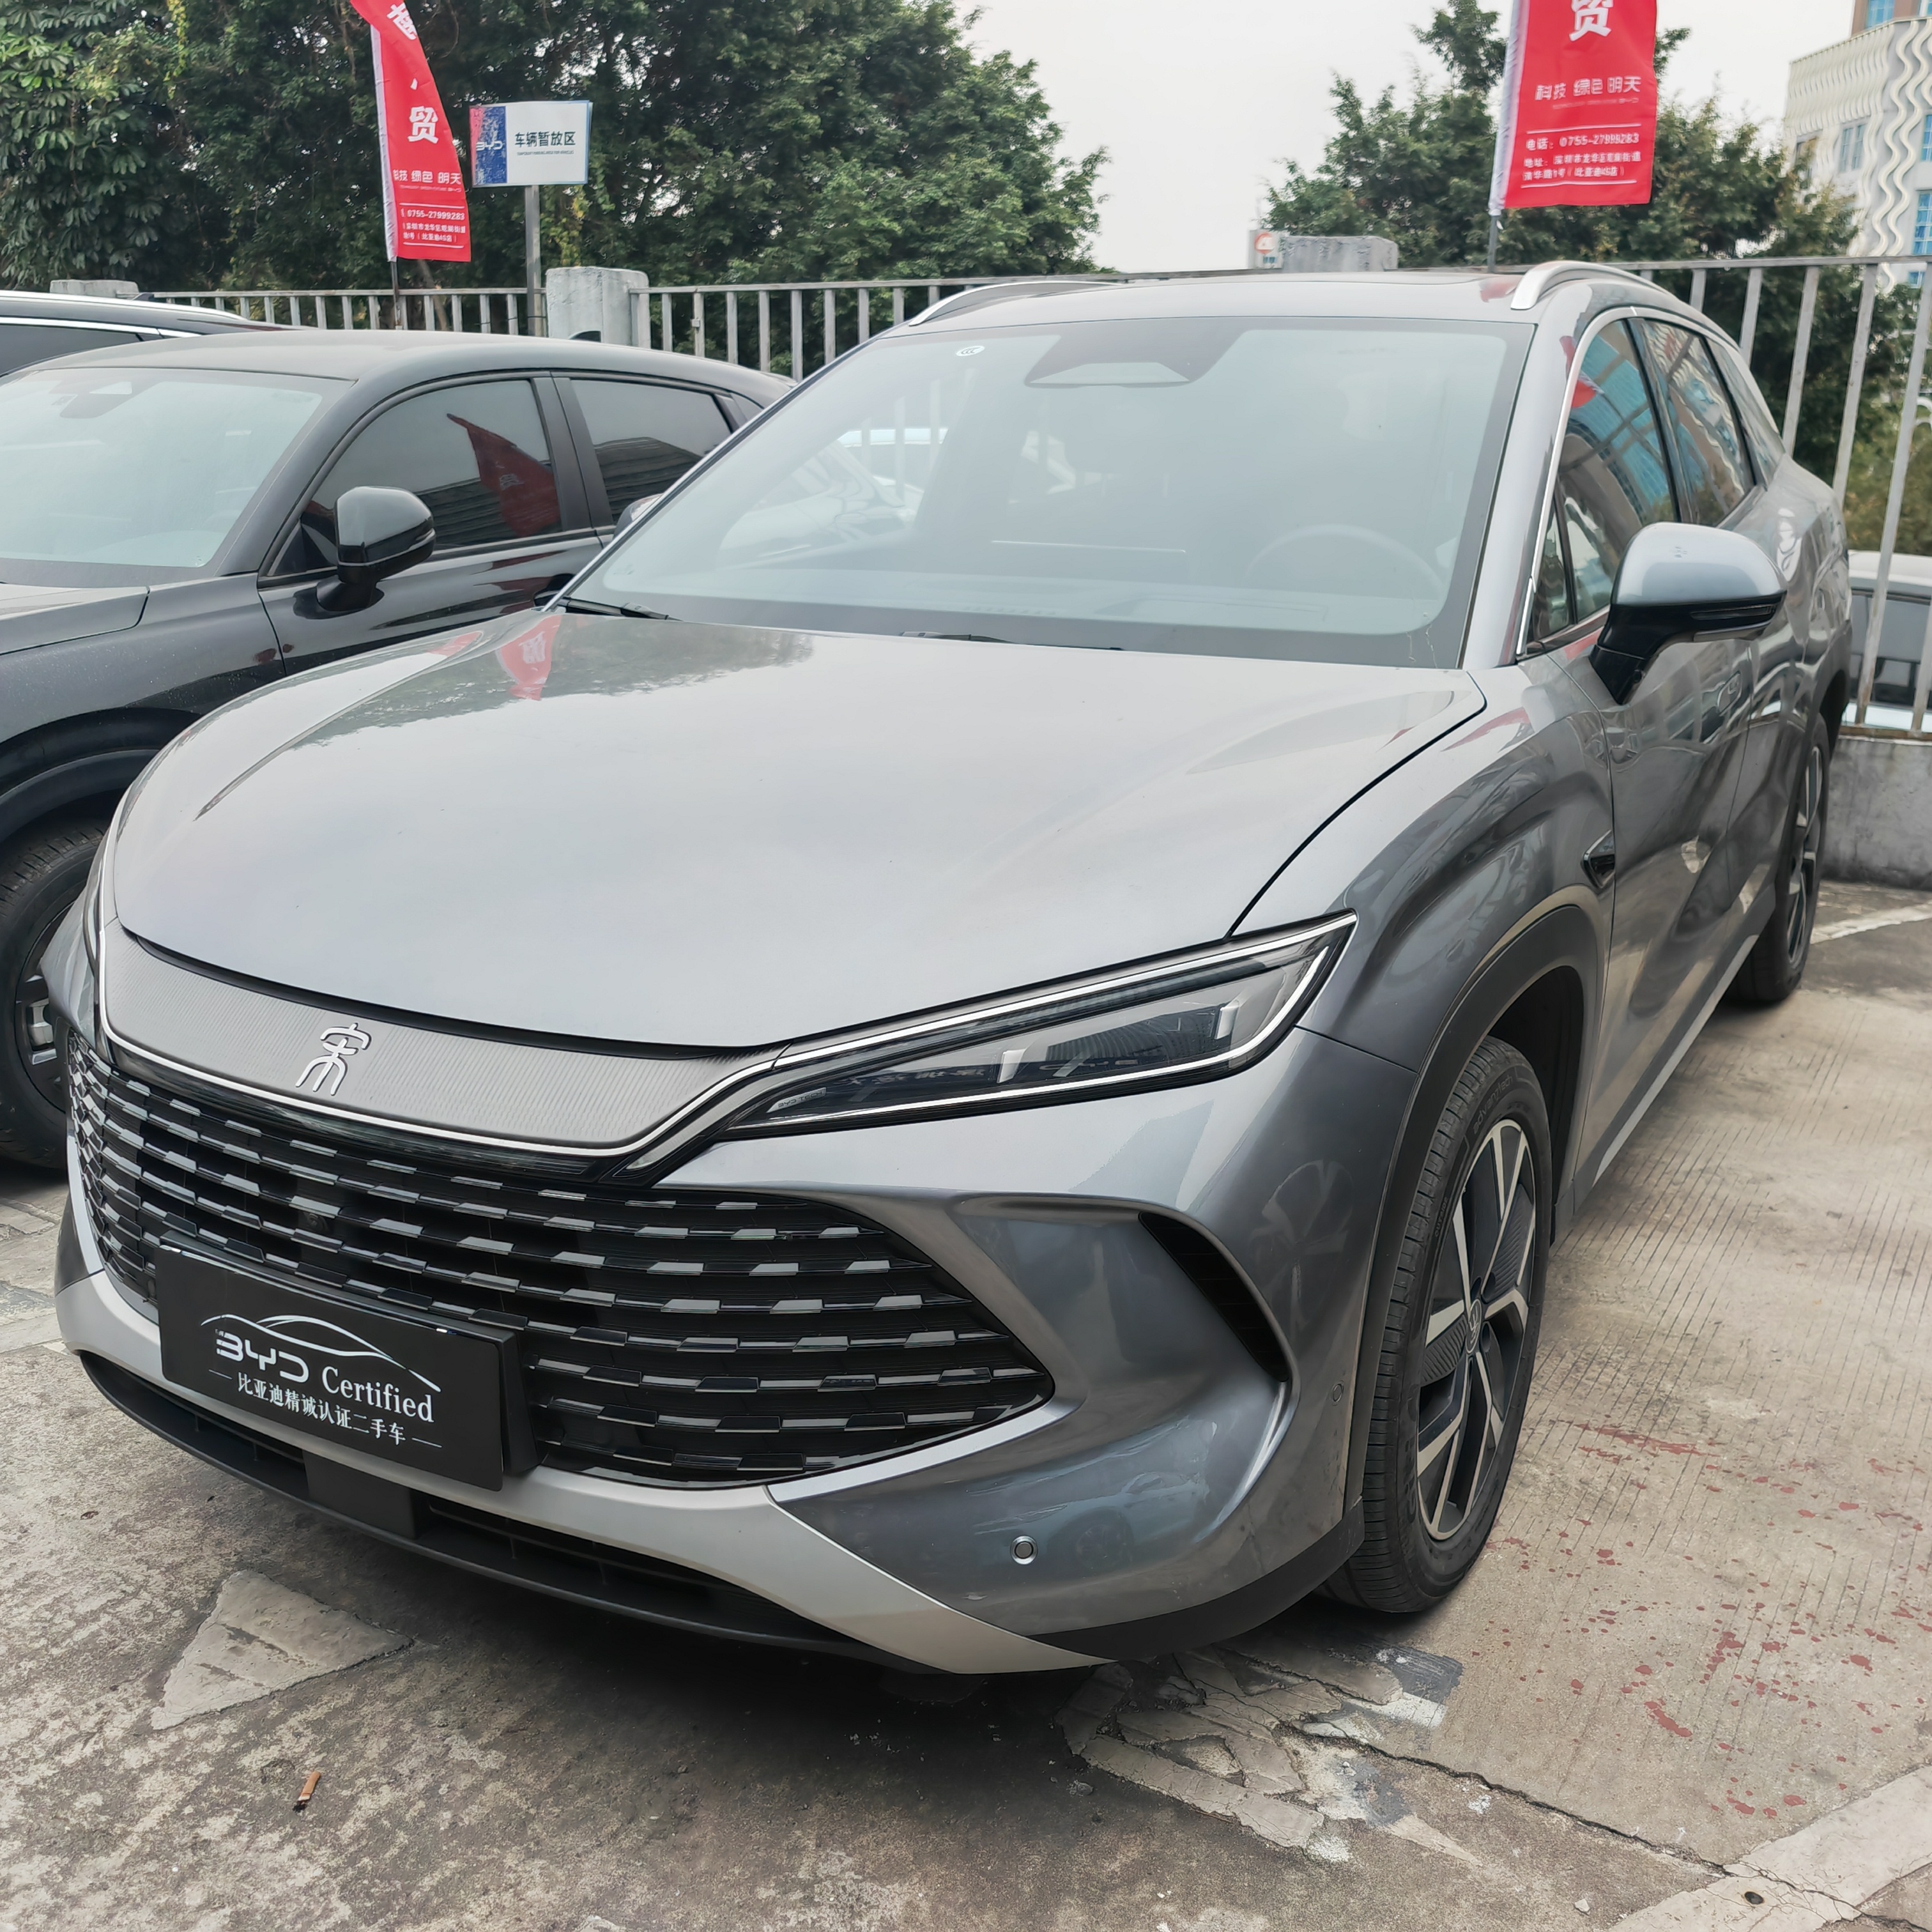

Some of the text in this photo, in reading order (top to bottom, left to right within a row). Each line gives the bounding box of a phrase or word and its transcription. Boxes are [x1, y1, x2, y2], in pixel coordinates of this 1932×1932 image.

[1535, 75, 1641, 100] 科技 绿色 明天
[408, 105, 438, 144] 贸
[475, 140, 503, 151] BYD
[514, 131, 576, 148] 车辆暂放区
[437, 171, 462, 185] 明天
[778, 1091, 823, 1108] BYD TECH
[216, 1329, 435, 1423] BYD Certified
[237, 1371, 407, 1446] 比亚迪精诚认证二手车
